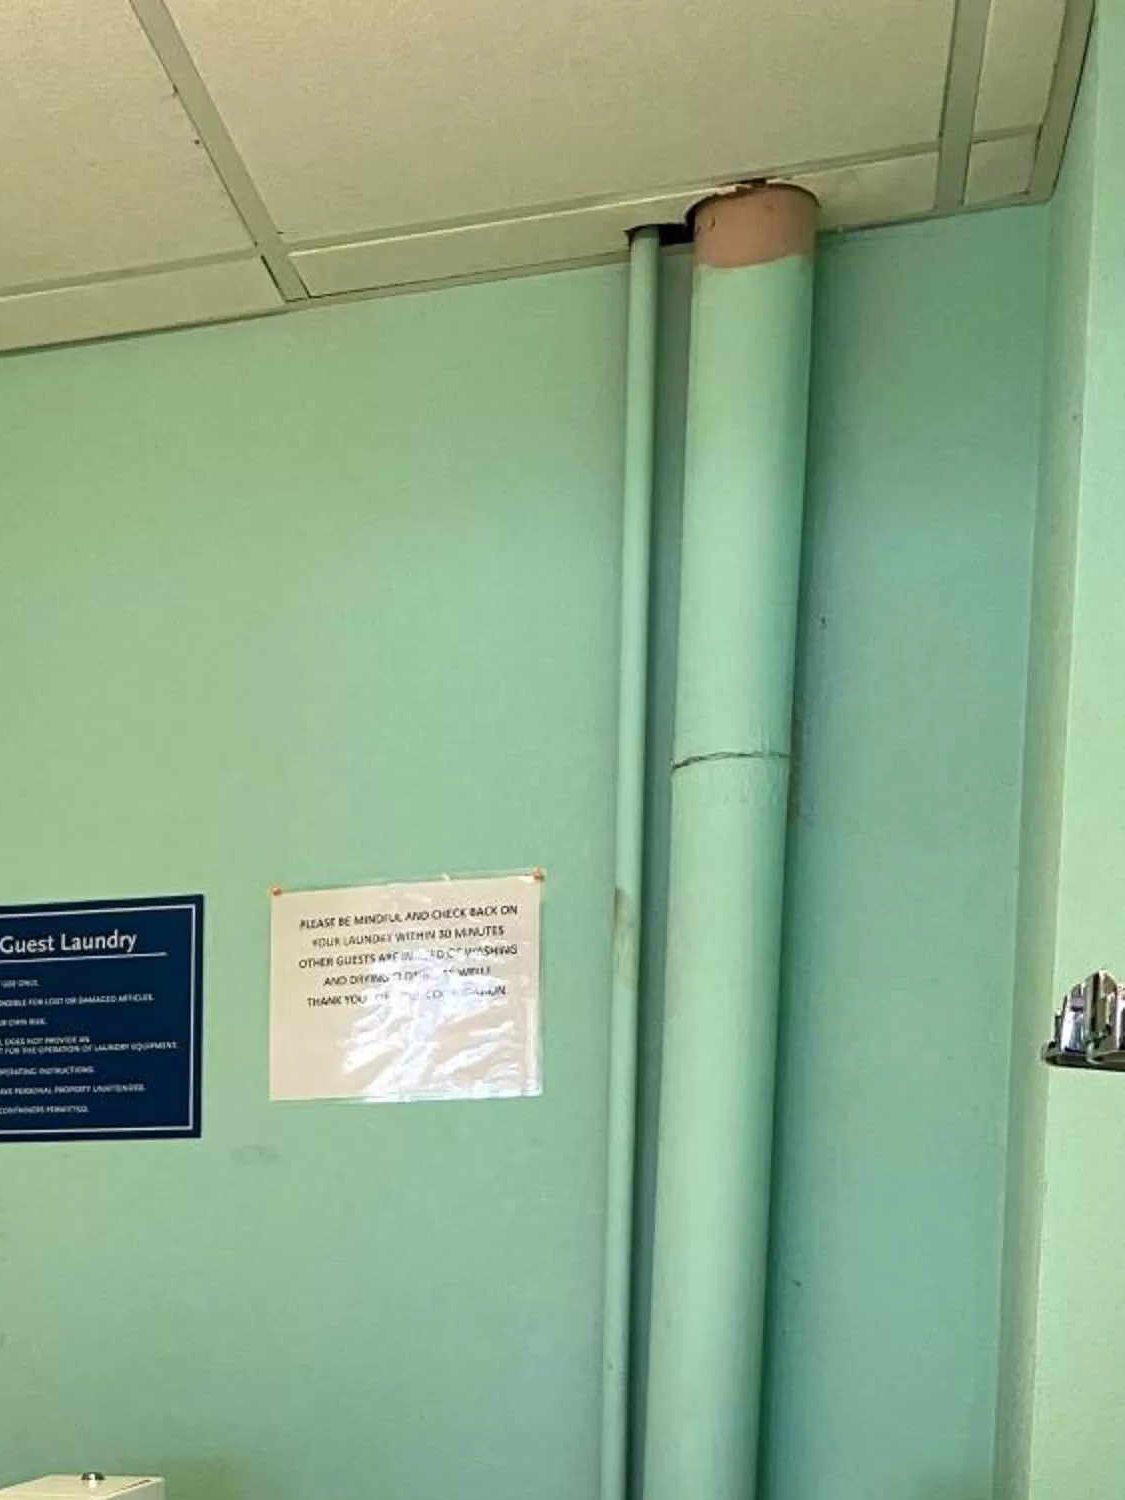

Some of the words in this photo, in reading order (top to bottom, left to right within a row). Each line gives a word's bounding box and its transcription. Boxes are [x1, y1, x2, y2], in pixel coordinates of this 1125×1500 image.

[300, 916, 335, 930] PLEASE
[338, 915, 351, 927] BE
[354, 912, 402, 925] MINDFUL
[404, 910, 429, 921] AND
[431, 907, 467, 920] CHECK
[469, 905, 498, 917] BACK
[500, 904, 518, 916] ON
[60, 928, 138, 953] Laundry
[312, 936, 340, 948] YOUR
[343, 932, 392, 947] LAUNDRY
[394, 929, 436, 943] WITHIN
[438, 927, 452, 939] 30
[454, 924, 505, 939] MINUTES
[298, 956, 334, 969] OTHER
[336, 952, 376, 967] GUESTS
[323, 975, 348, 987] AND
[306, 995, 342, 1009] THANK
